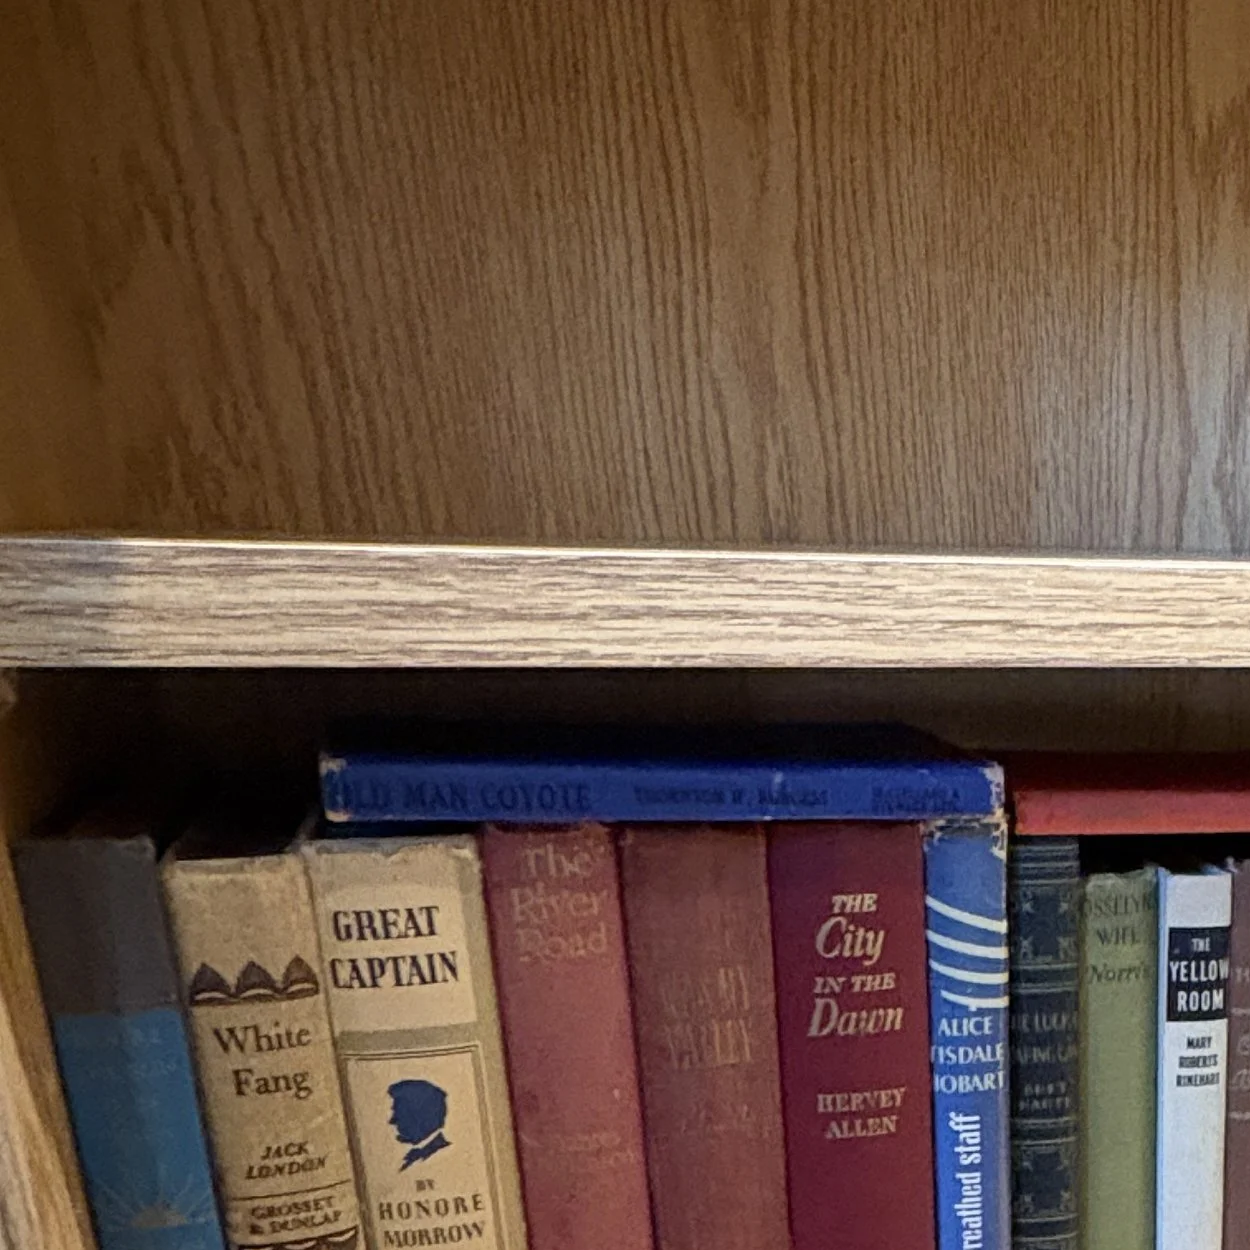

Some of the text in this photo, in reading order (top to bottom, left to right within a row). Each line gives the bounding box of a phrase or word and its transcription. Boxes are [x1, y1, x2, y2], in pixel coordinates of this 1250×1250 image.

[831, 893, 878, 914] THE
[332, 905, 440, 941] GREAT
[815, 916, 885, 966] City
[1191, 938, 1210, 952] THE
[329, 950, 460, 989] CAPTAIN
[1169, 957, 1230, 983] YELLOW
[813, 972, 896, 994] IN THE
[1177, 988, 1224, 1012] ROOM
[807, 997, 904, 1037] Dawn
[937, 1016, 993, 1036] ALICE
[213, 1020, 312, 1055] White
[1186, 1036, 1213, 1049] MARY
[1178, 1054, 1218, 1069] ROBERTS
[232, 1068, 313, 1100] Fang
[1176, 1072, 1220, 1087] RINEHART
[817, 1087, 907, 1113] HERVEY
[826, 1115, 899, 1139] ALLEN
[949, 1111, 982, 1166] staff
[261, 1141, 309, 1161] JACK
[245, 1155, 328, 1180] LONDON
[415, 1178, 435, 1192] BY
[251, 1196, 334, 1220] GROSSET
[269, 1210, 342, 1234] DUNLAP
[383, 1220, 485, 1249] MORROW
